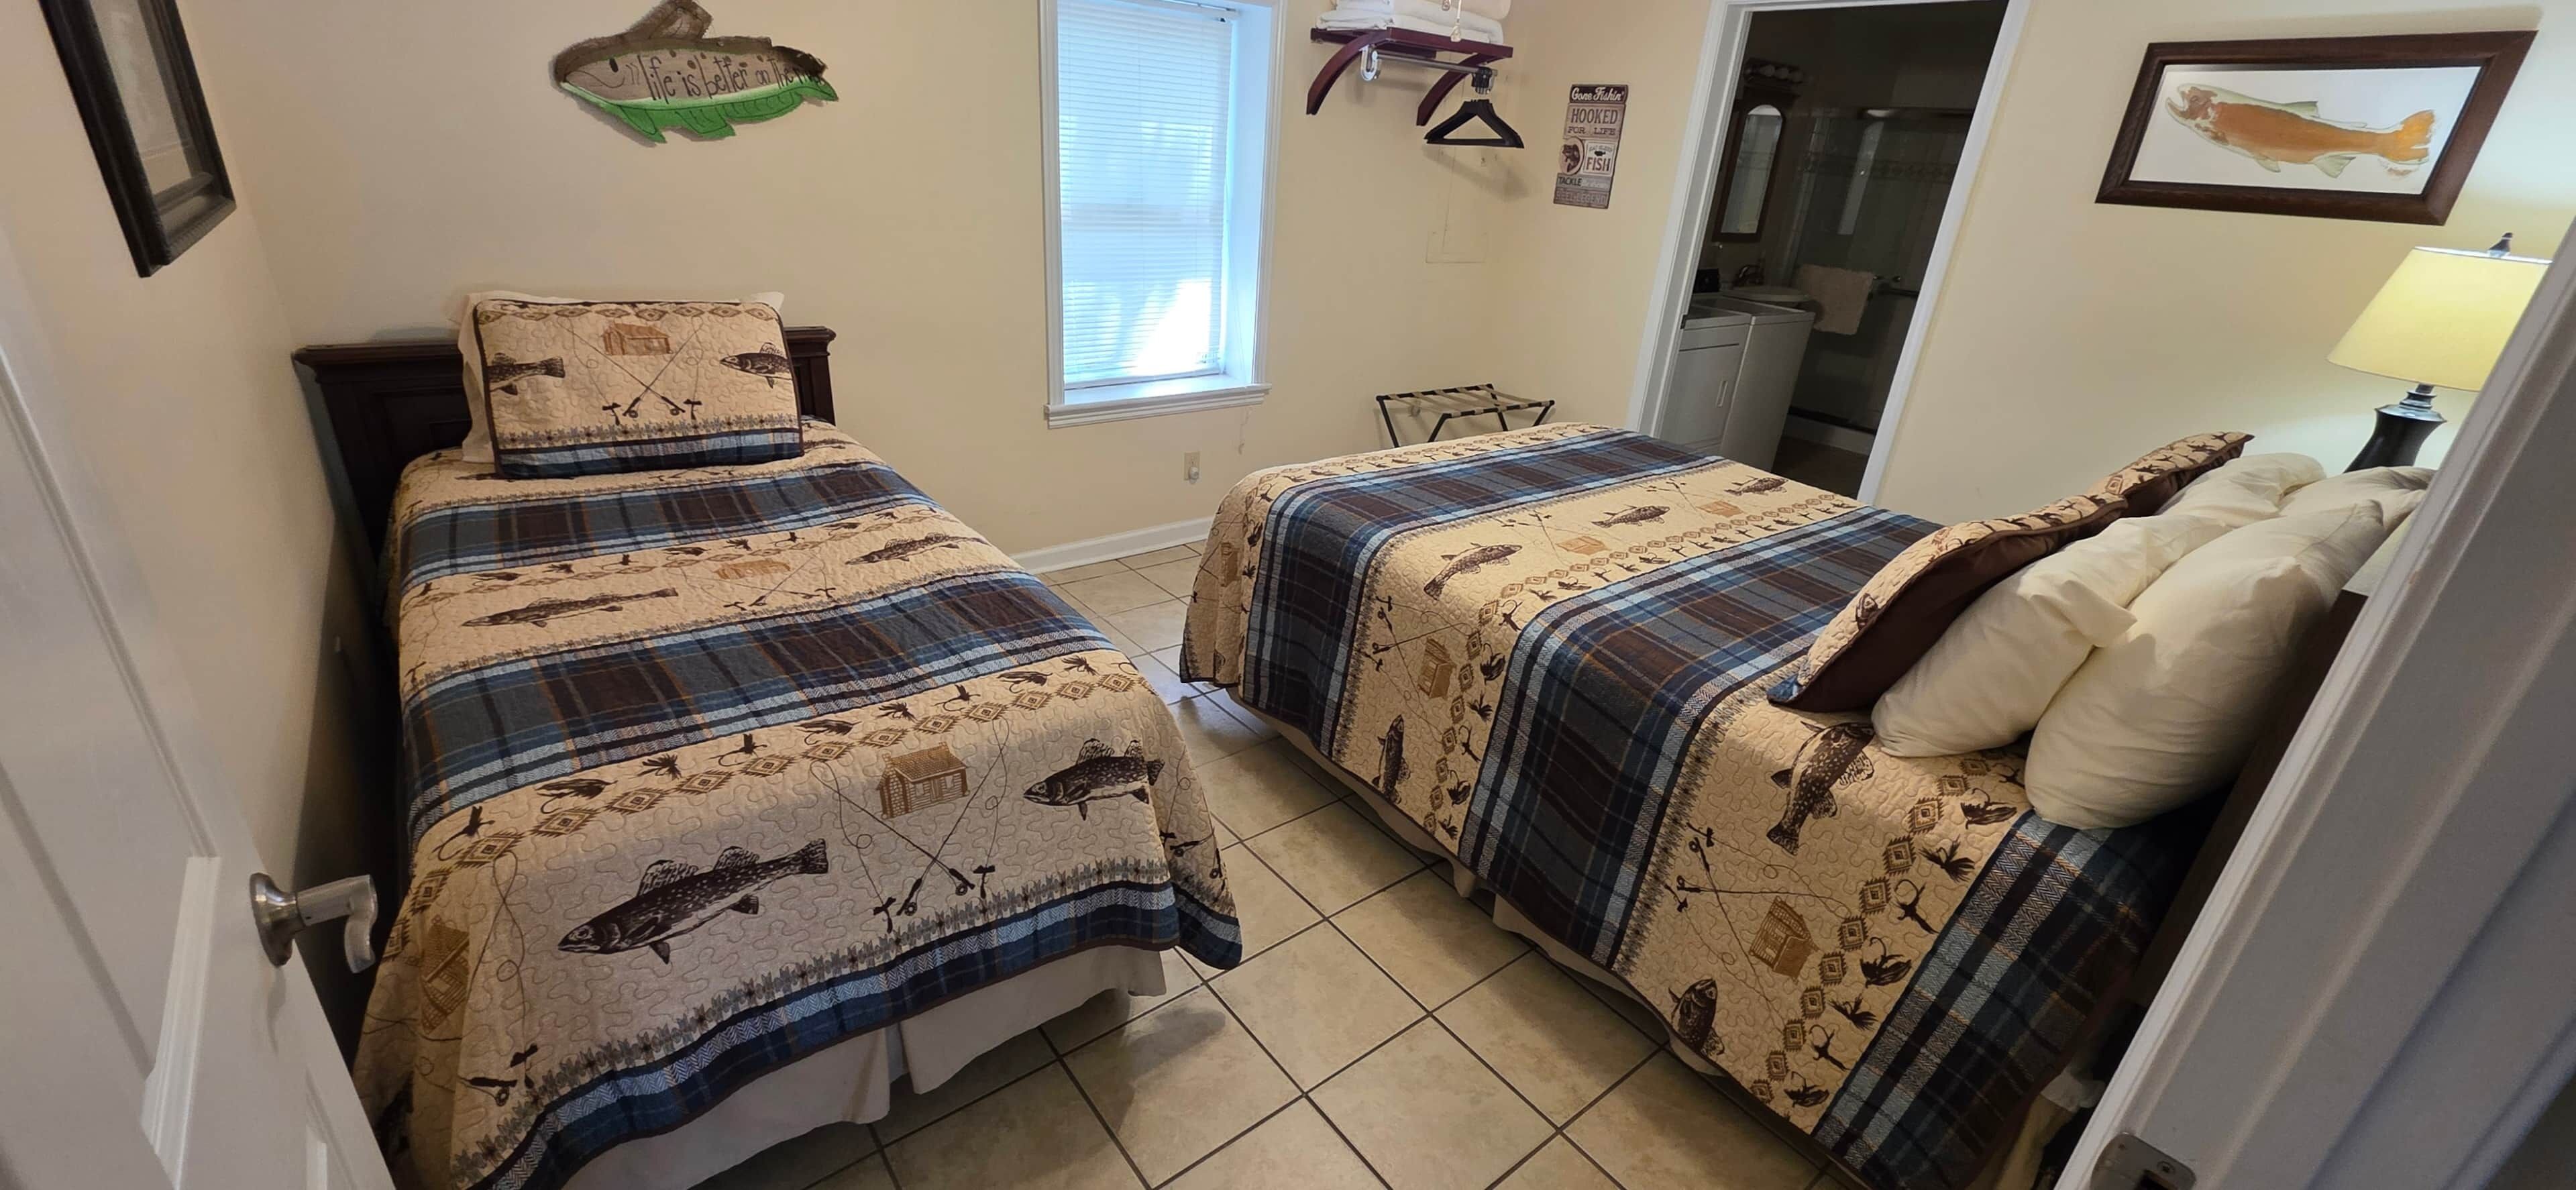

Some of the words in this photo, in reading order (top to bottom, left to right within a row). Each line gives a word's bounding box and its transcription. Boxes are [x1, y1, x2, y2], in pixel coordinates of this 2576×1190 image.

[637, 55, 676, 105] life
[677, 70, 702, 97] is
[693, 55, 749, 99] better
[755, 69, 771, 86] on
[1571, 87, 1593, 101] Gone
[1593, 87, 1625, 101] Fishin'
[1570, 108, 1619, 125] HOOKED
[1567, 125, 1586, 134] FOR
[1593, 127, 1616, 136] LIFE
[1586, 156, 1611, 172] FISH
[1558, 176, 1582, 186] TACKLE
